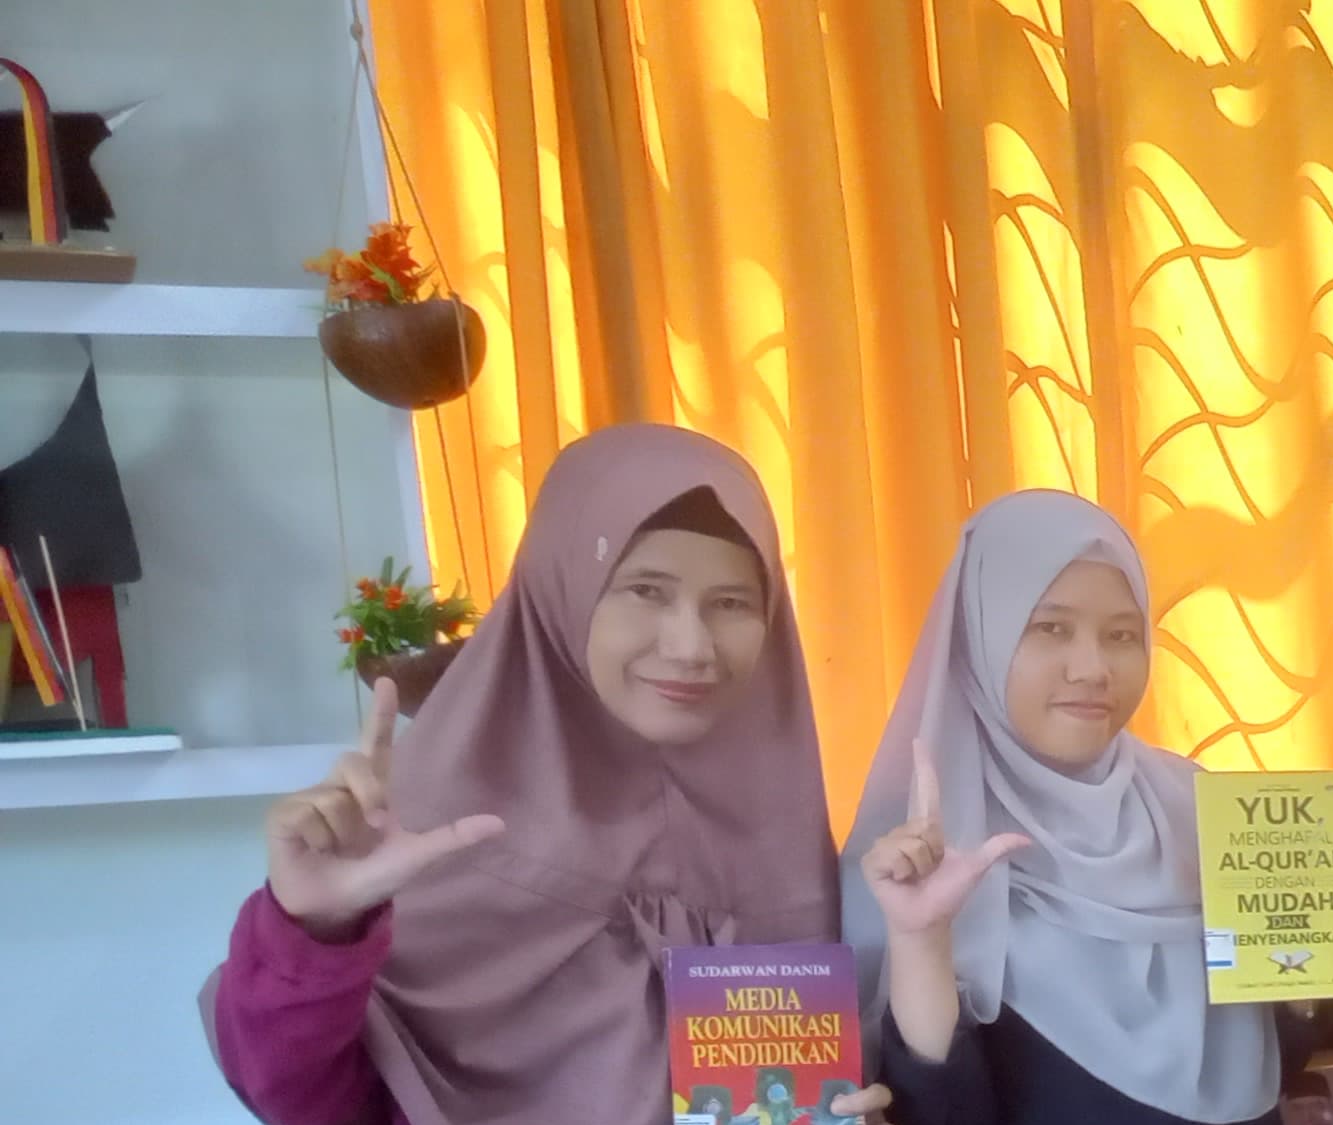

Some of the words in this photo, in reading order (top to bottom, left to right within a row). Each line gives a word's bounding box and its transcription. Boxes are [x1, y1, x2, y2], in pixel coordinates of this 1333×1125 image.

[1255, 876, 1316, 889] DENGAN
[1271, 916, 1304, 929] DAN
[689, 965, 778, 978] SUDARWAN
[781, 965, 831, 977] DANIM
[725, 987, 803, 1012] MEDIA
[687, 1013, 841, 1041] KOMUNIKASI
[692, 1041, 840, 1068] PENDIDIKAN
